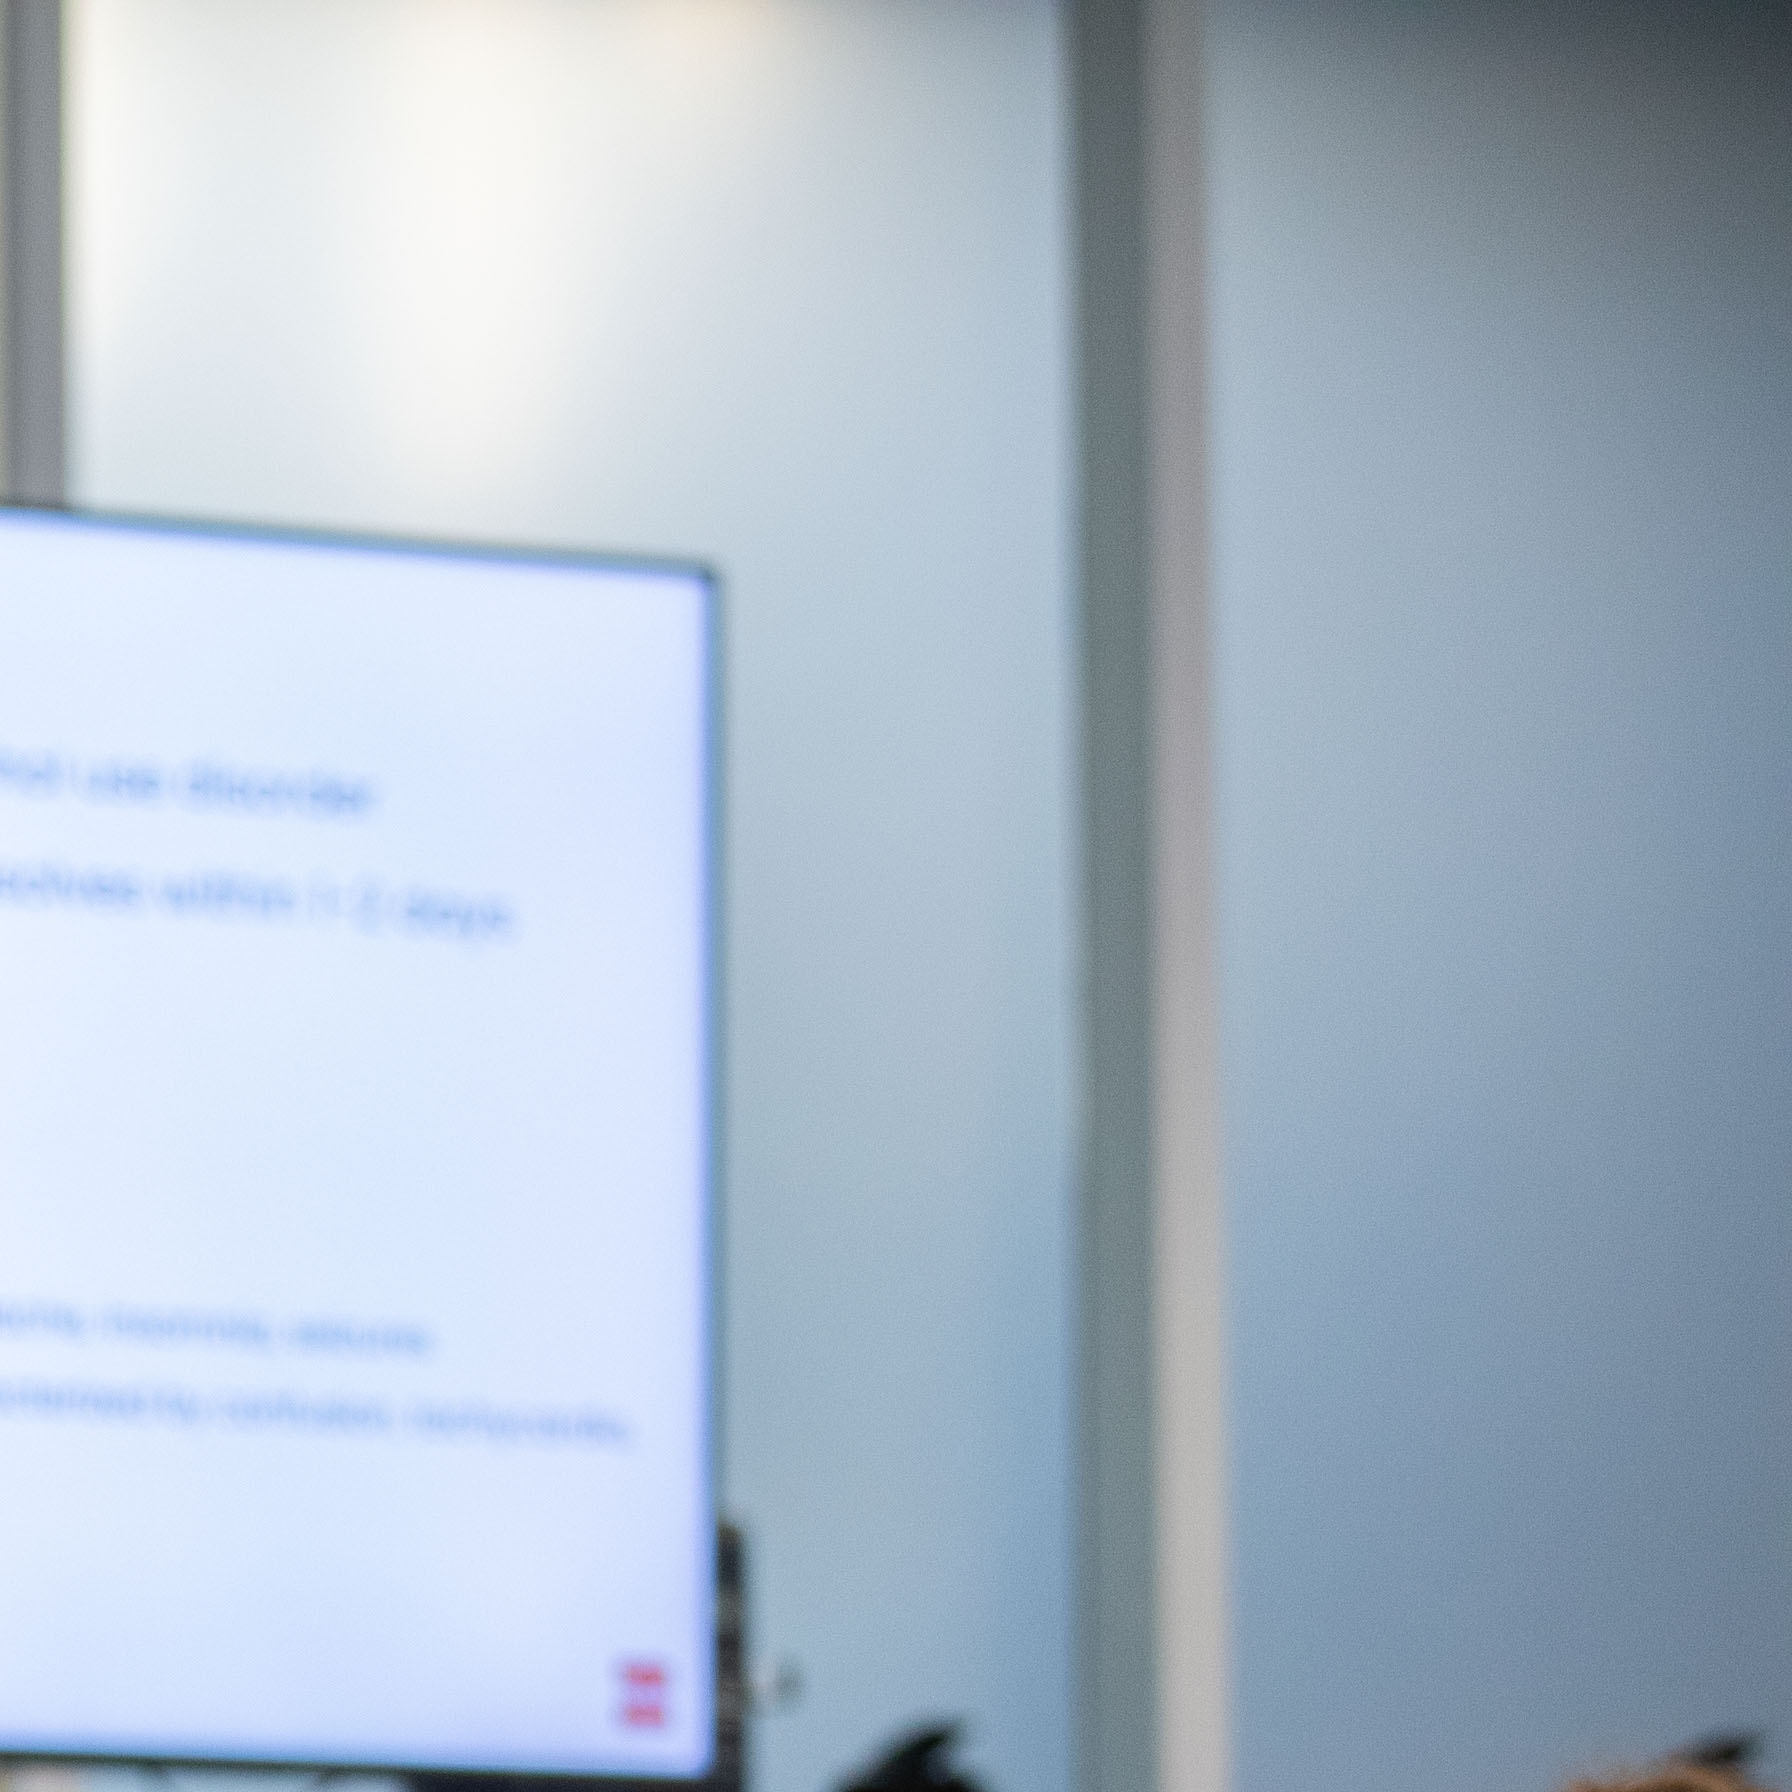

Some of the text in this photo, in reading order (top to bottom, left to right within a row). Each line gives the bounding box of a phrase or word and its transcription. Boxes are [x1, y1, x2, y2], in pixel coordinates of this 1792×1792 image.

[75, 753, 171, 805] use
[175, 750, 379, 820] disorder
[156, 860, 302, 926] within
[391, 876, 518, 954] days
